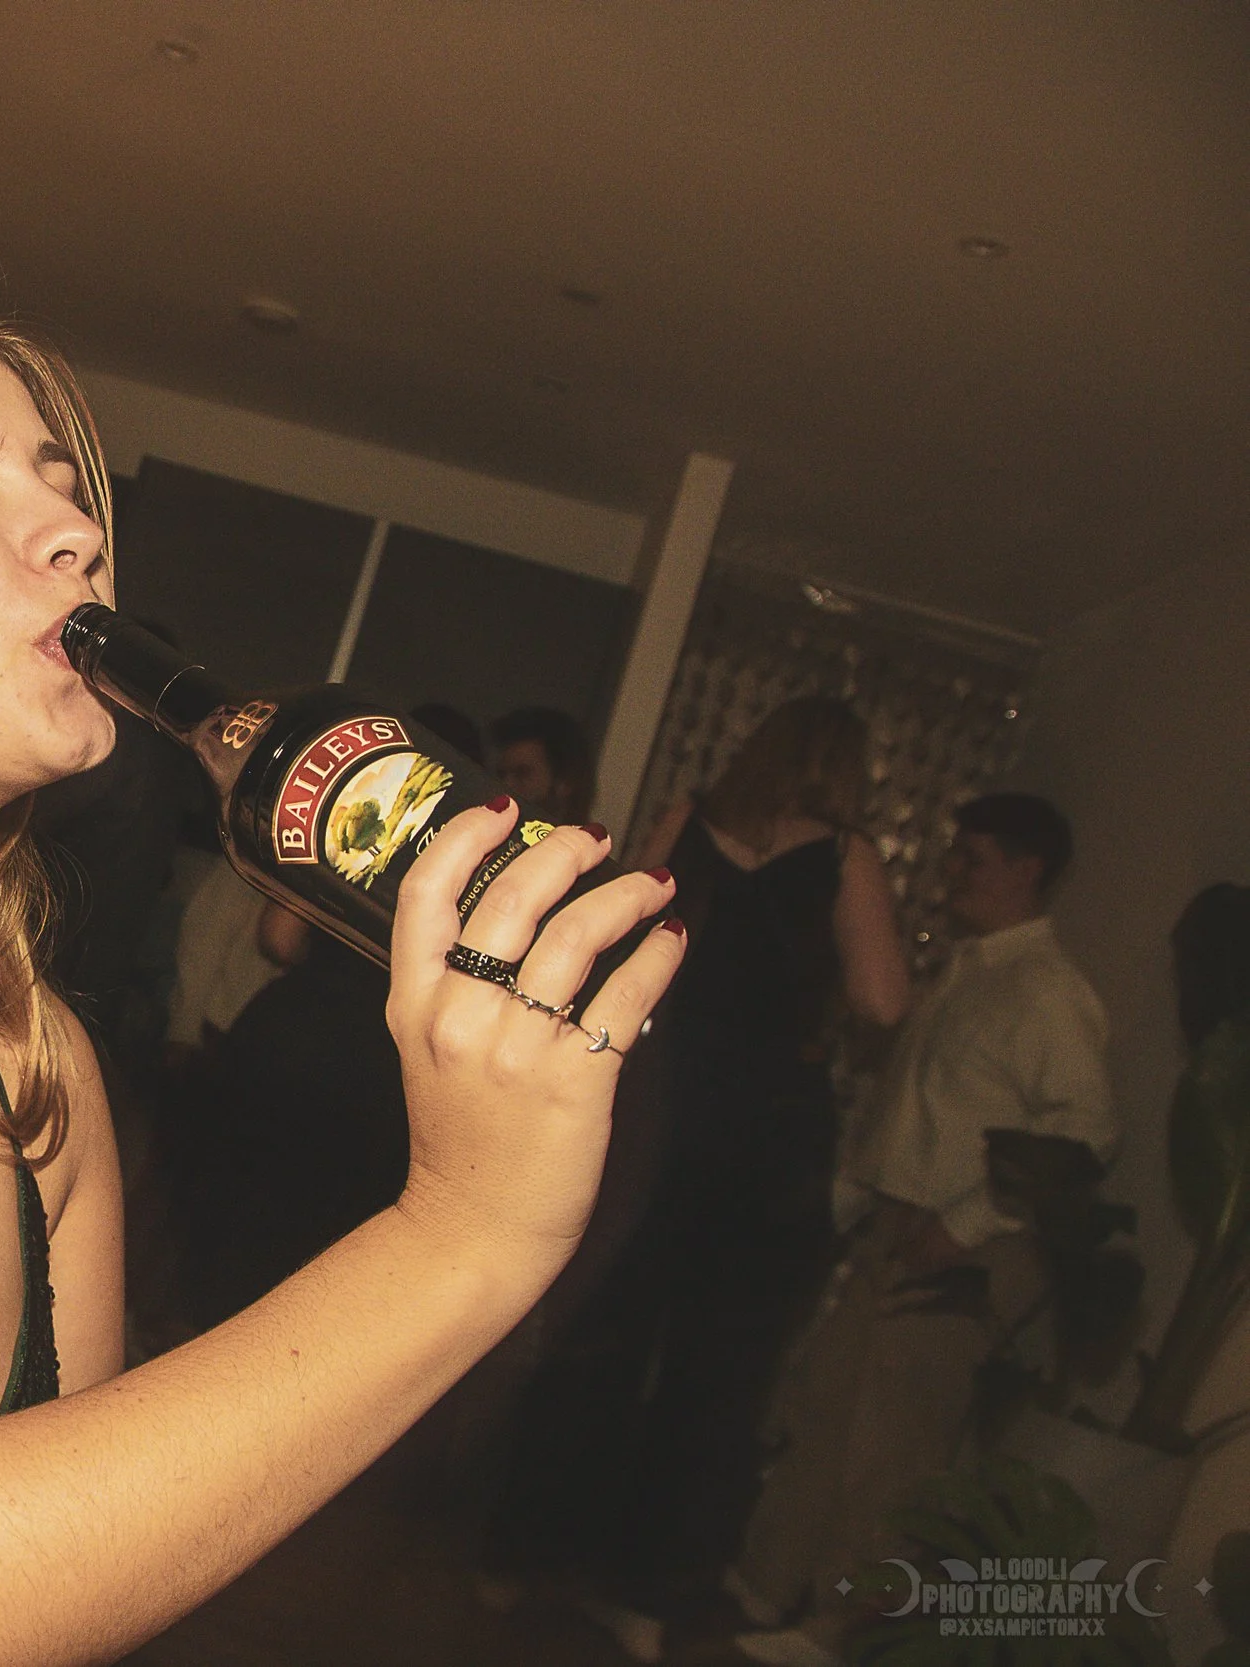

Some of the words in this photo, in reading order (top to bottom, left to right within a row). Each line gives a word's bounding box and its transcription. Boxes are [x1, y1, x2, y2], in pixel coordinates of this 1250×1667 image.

[282, 722, 395, 851] BAILEYS
[416, 823, 446, 856] Th
[458, 880, 485, 918] RODUCT
